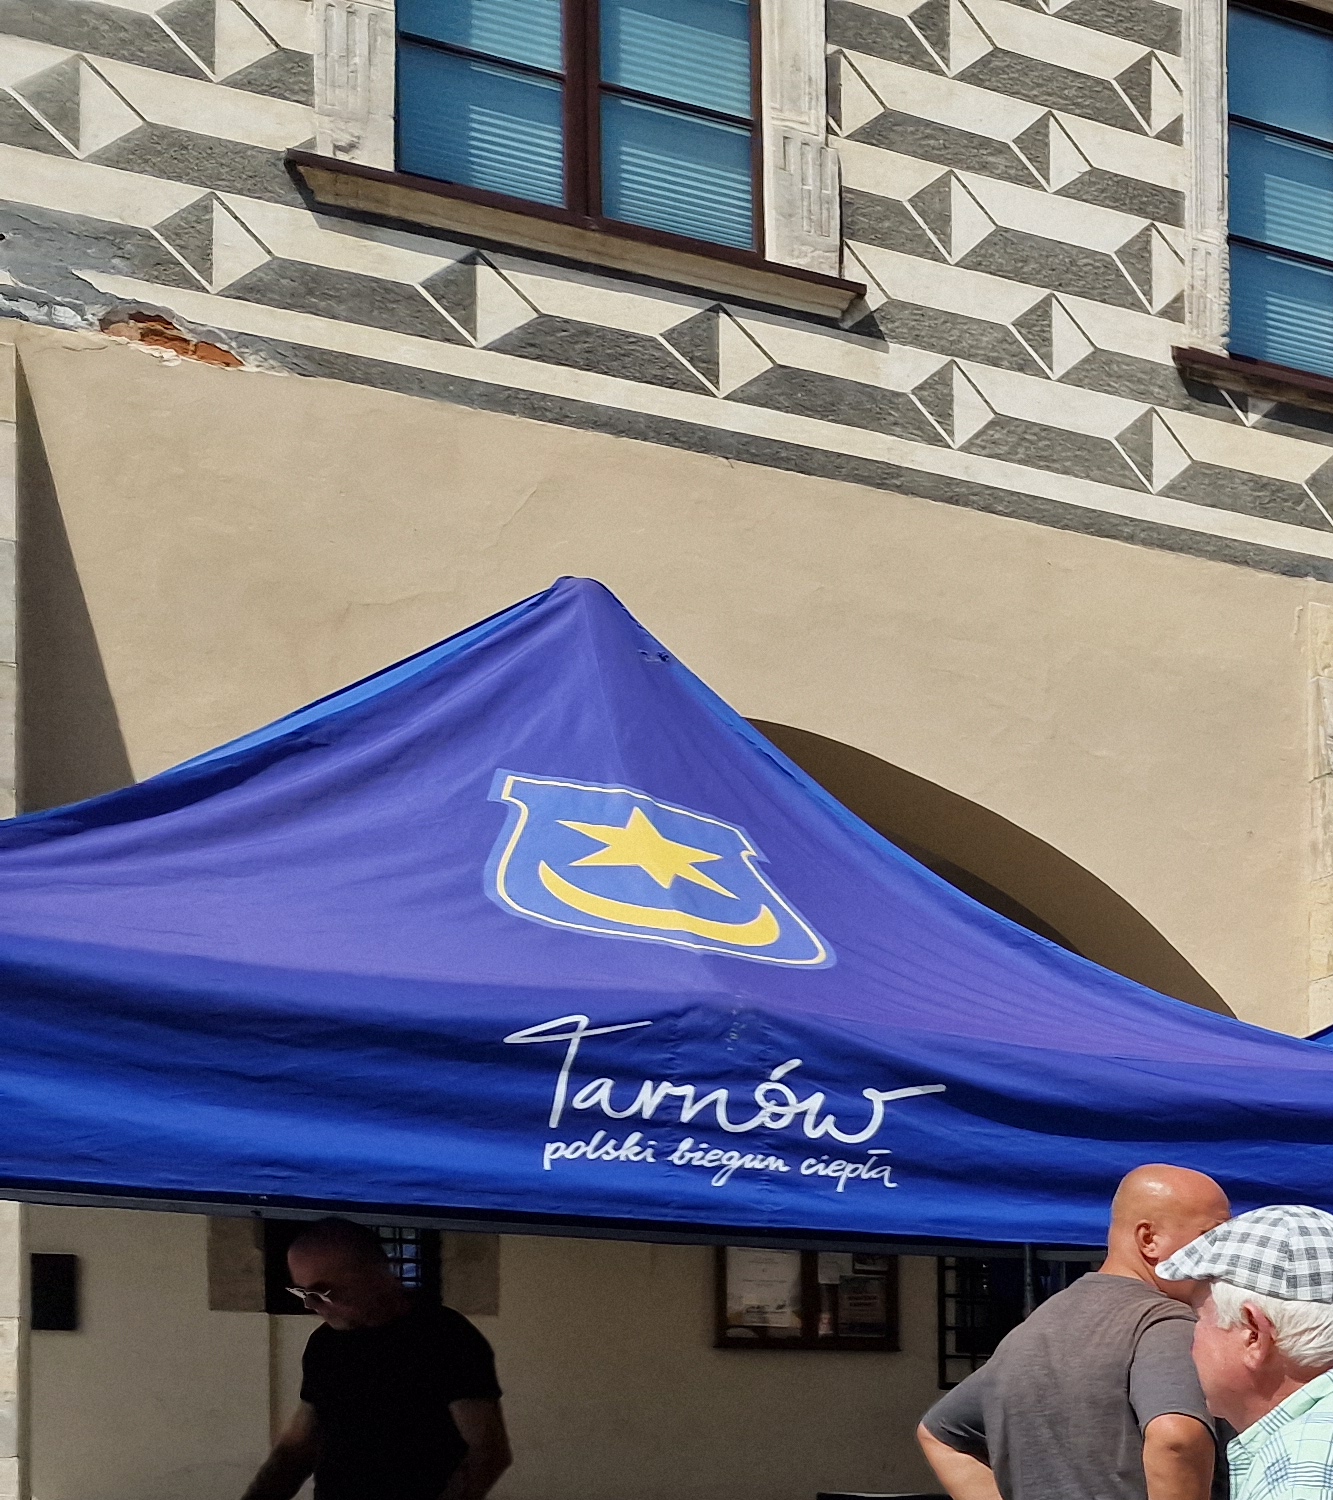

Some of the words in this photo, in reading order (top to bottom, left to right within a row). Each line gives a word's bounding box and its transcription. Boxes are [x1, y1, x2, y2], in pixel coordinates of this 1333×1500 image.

[503, 1014, 946, 1144] Tarnów
[543, 1130, 657, 1171] polski
[670, 1136, 792, 1187] biegun
[800, 1149, 899, 1192] ciepła
